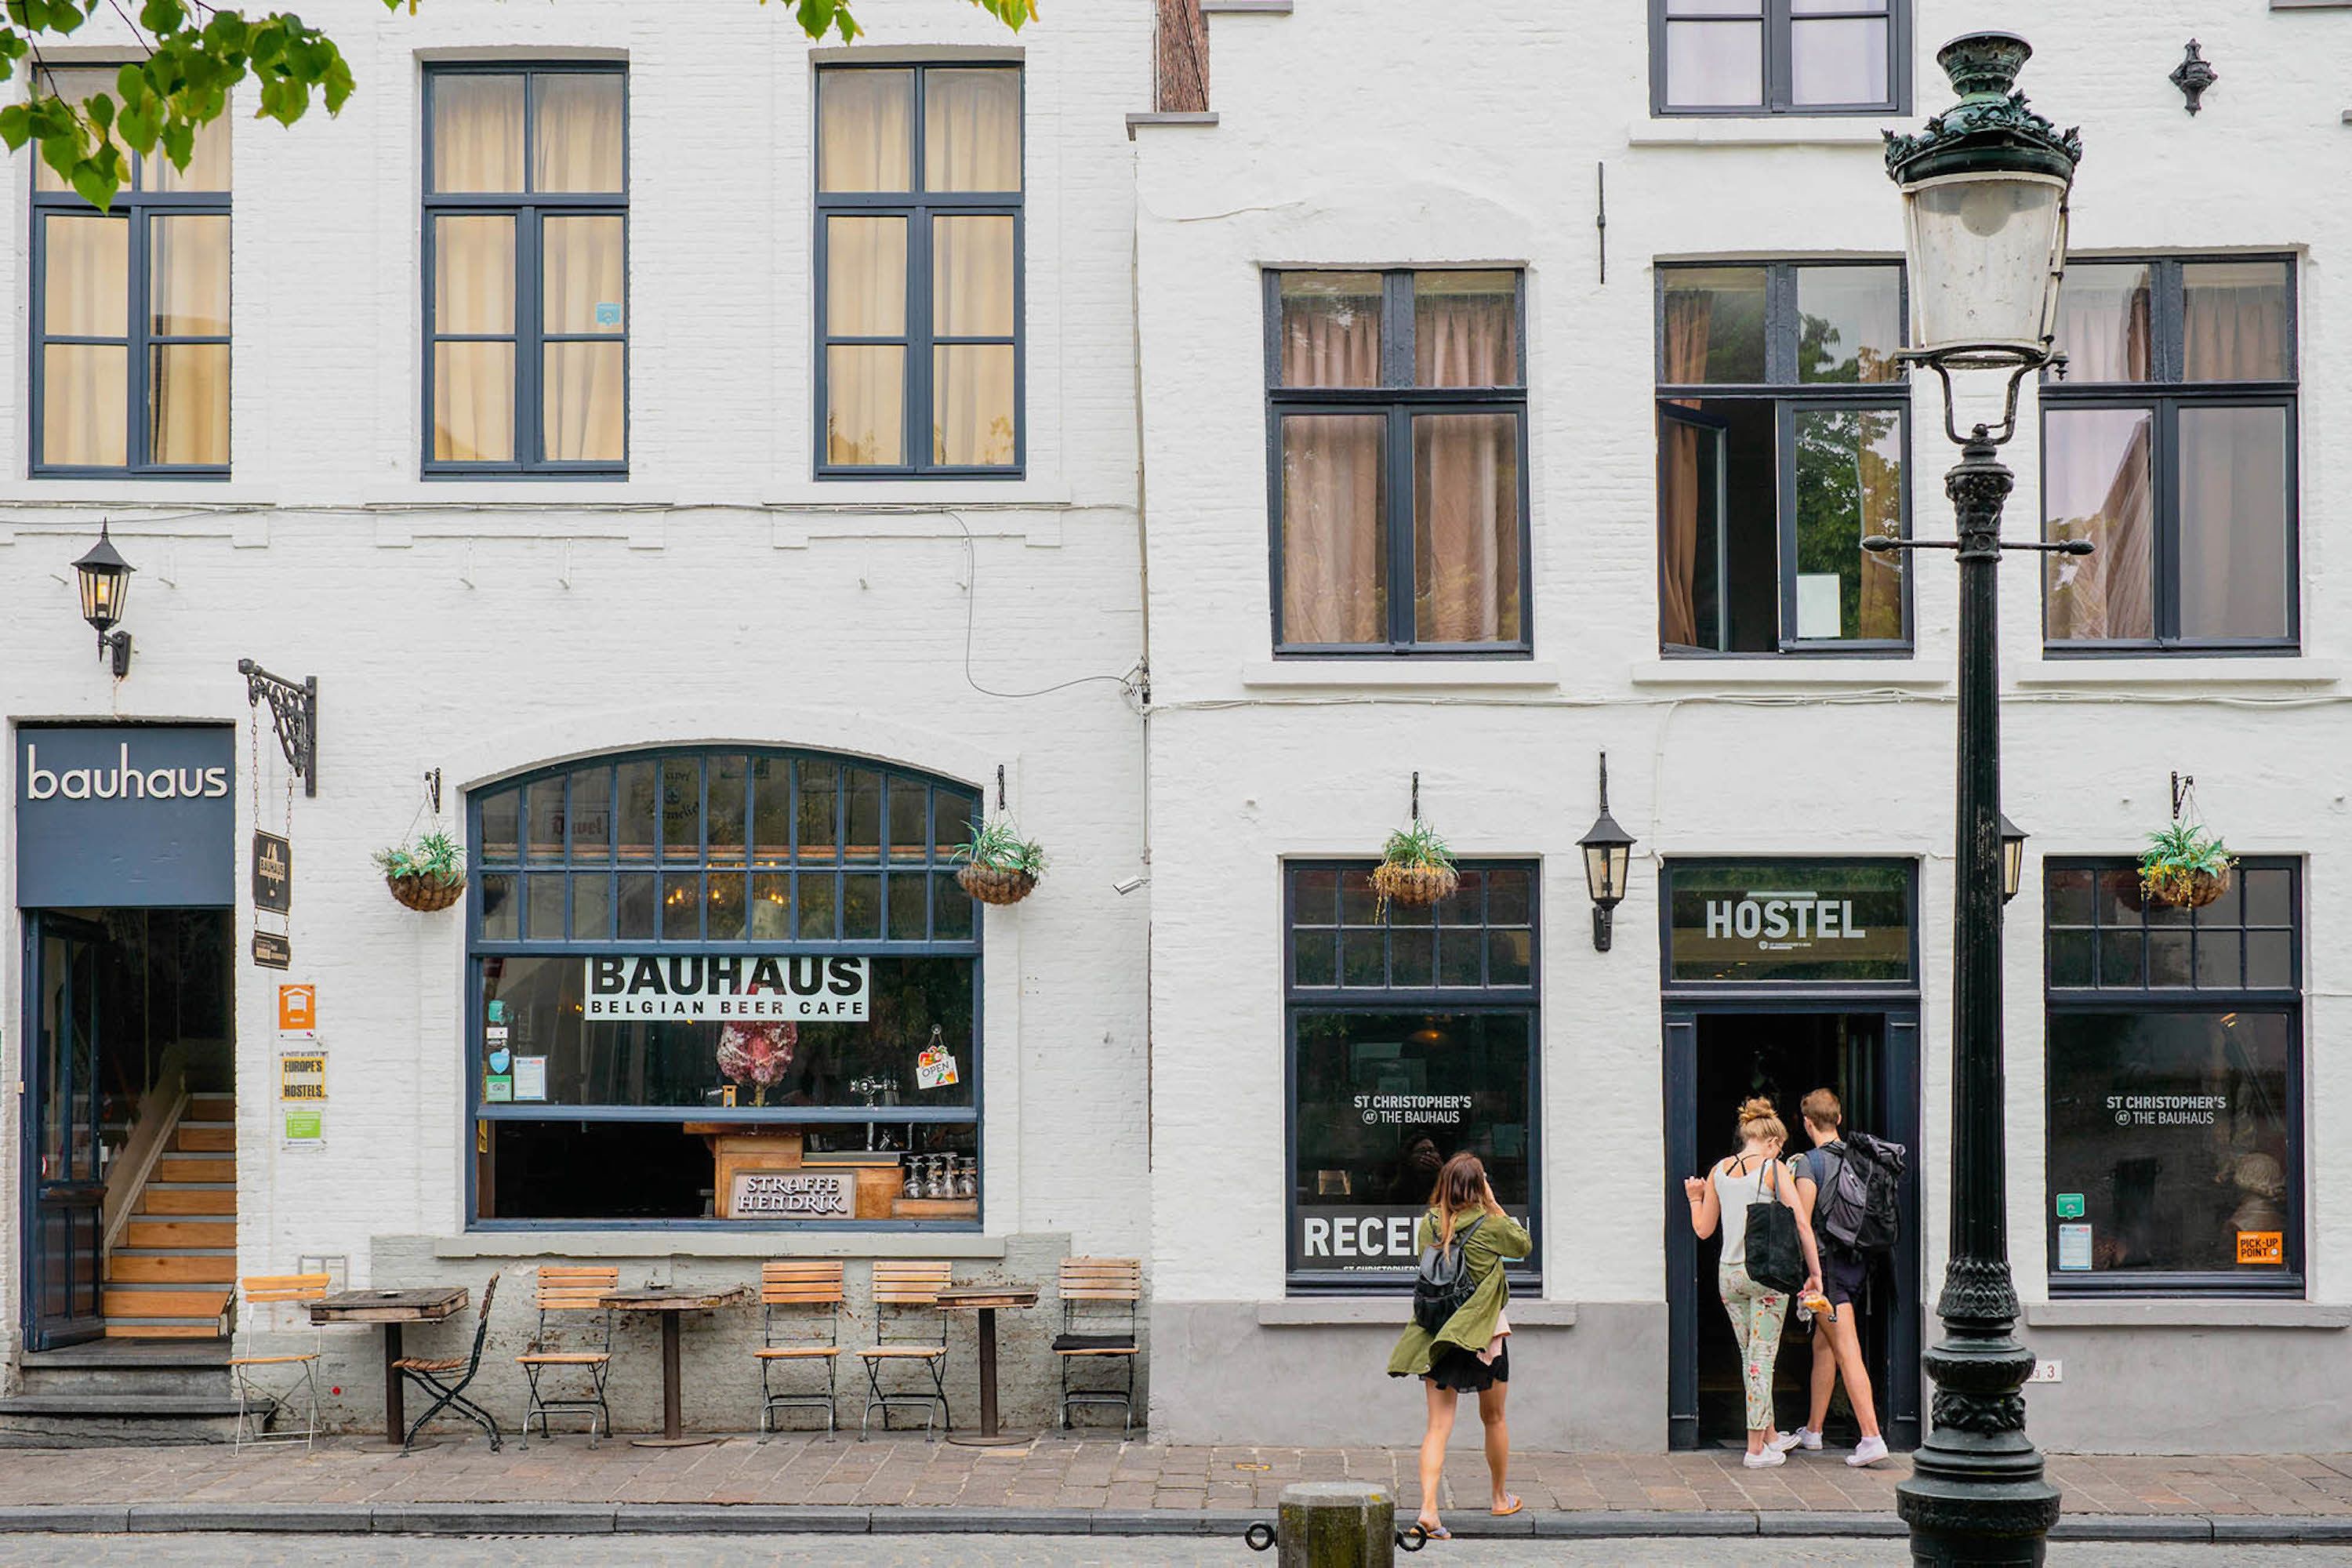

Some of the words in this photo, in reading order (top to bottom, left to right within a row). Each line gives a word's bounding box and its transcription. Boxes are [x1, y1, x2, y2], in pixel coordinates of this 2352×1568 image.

[27, 742, 228, 800] bauhaus
[1706, 900, 1866, 939] HOSTEL
[591, 957, 863, 996] BAUHAUS
[591, 1000, 704, 1014] BELGIAN
[720, 1000, 783, 1014] BEER
[799, 1001, 862, 1014] CAFE
[922, 1062, 949, 1077] OPEN
[284, 1084, 321, 1098] HOSTELS
[1354, 1095, 1371, 1109] ST
[1372, 1095, 1472, 1109] CHRISTOPHER'S
[2107, 1096, 2123, 1109] ST
[2125, 1095, 2227, 1109] CHRISTOPHER'S
[1380, 1110, 1403, 1123] THE
[1404, 1110, 1461, 1123] BAUHAUS
[2132, 1111, 2155, 1124] THE
[2158, 1111, 2215, 1124] BAUHAUS
[747, 1177, 840, 1196] STRAFFE
[738, 1192, 848, 1214] HENDRIK
[2241, 1238, 2278, 1248] PICK-UP
[2241, 1247, 2268, 1258] POINT
[2047, 1364, 2054, 1379] 3
